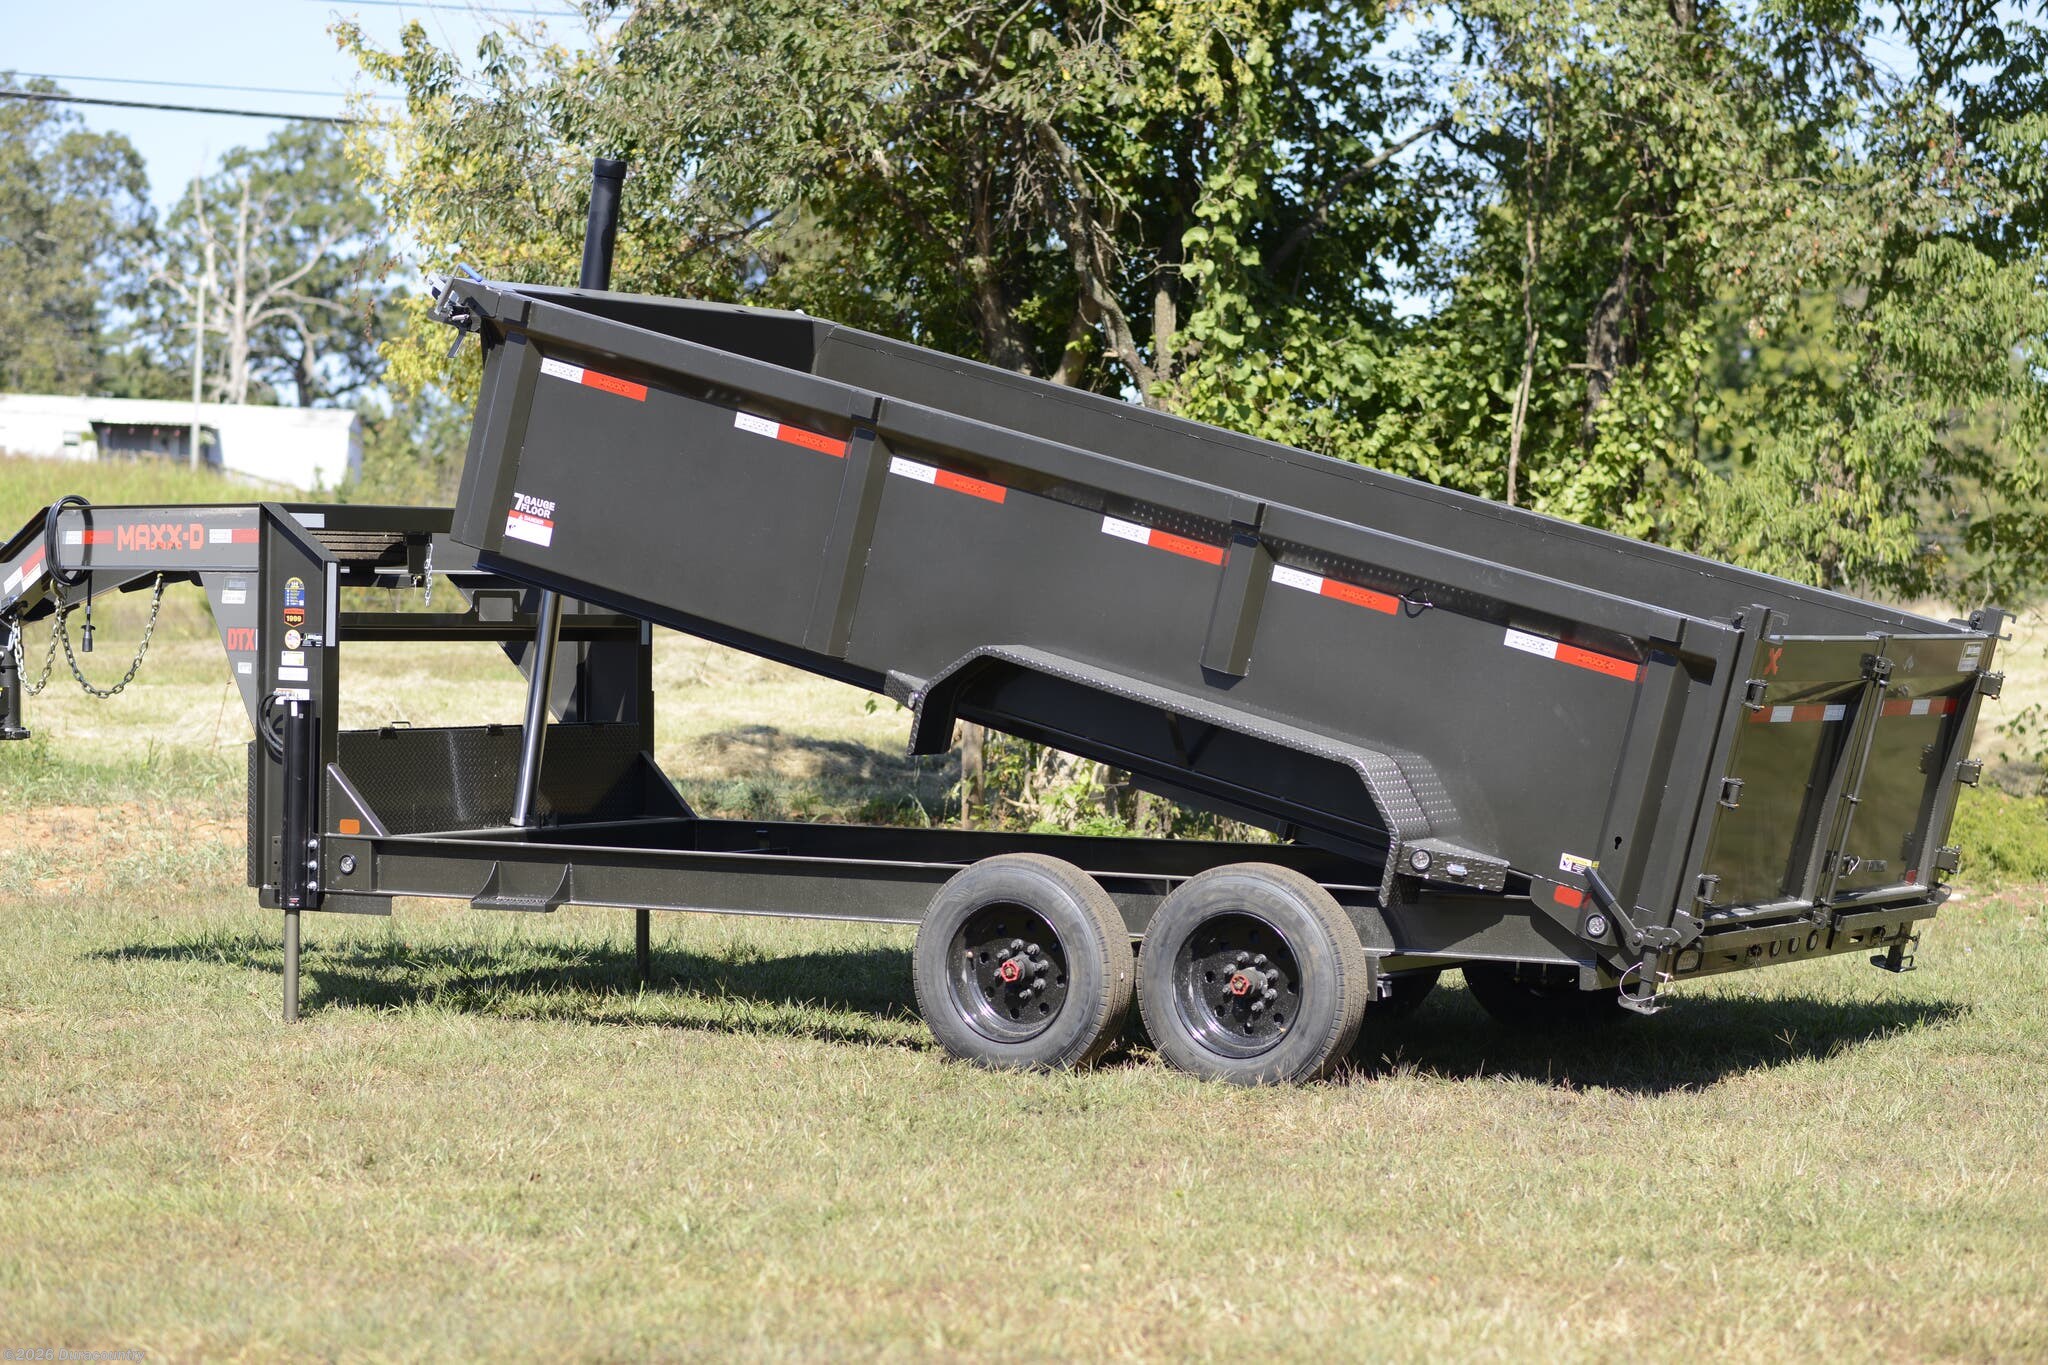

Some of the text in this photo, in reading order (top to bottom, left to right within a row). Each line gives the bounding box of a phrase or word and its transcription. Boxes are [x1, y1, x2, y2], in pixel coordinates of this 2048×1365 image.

[513, 492, 556, 511] 7 GAUGE
[520, 503, 551, 519] FLOOR
[116, 523, 204, 551] MAXX-D
[227, 628, 255, 650] DTX
